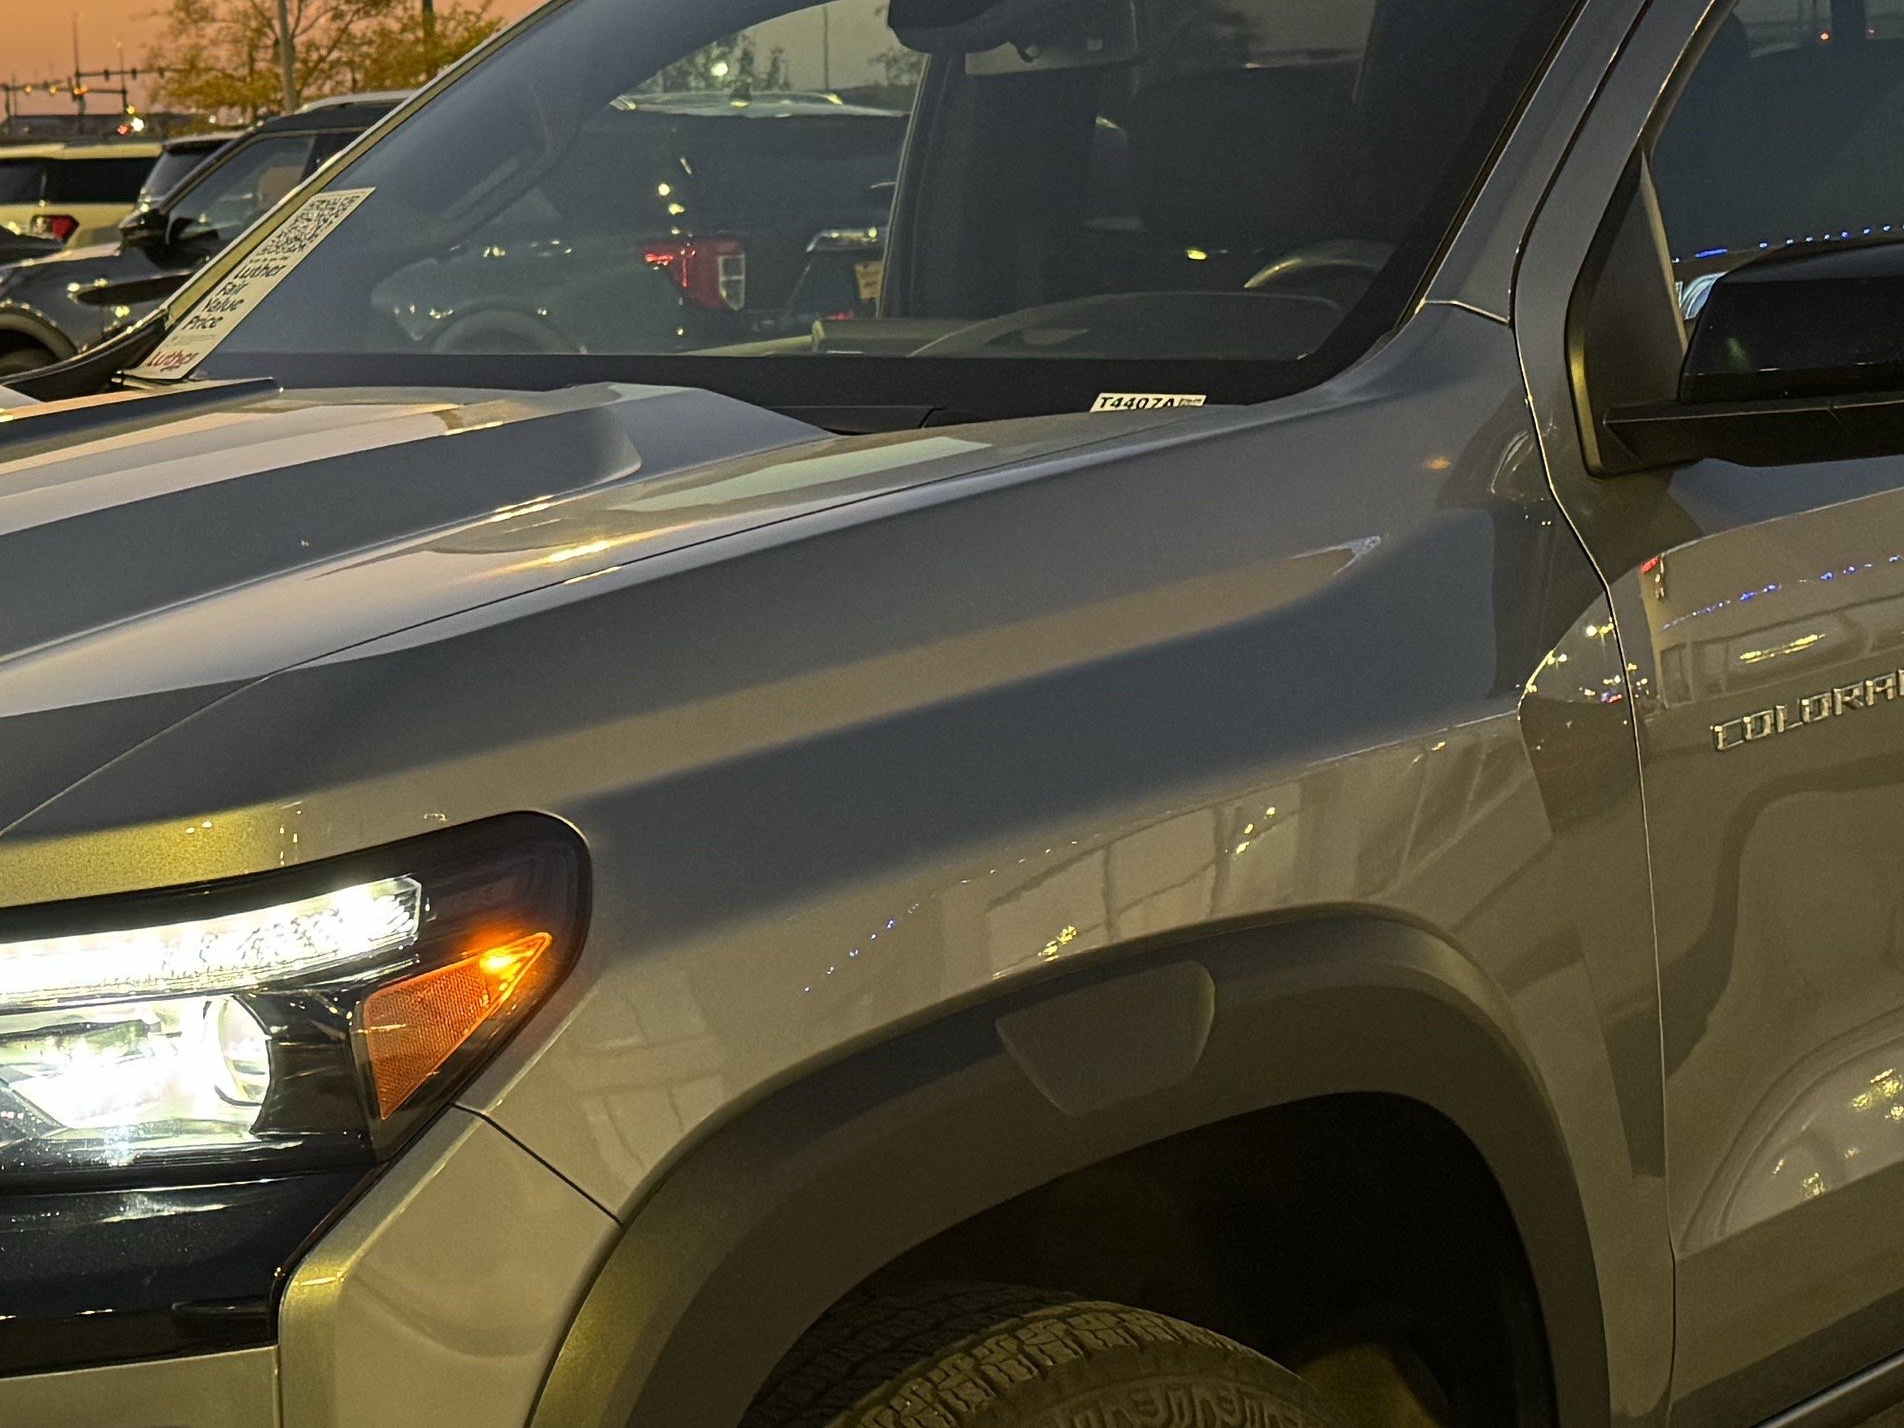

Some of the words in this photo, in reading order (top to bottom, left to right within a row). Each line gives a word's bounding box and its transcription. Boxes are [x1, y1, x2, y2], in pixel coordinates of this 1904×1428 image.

[216, 281, 249, 295] Fair
[202, 298, 244, 312] Value
[182, 314, 224, 330] Price
